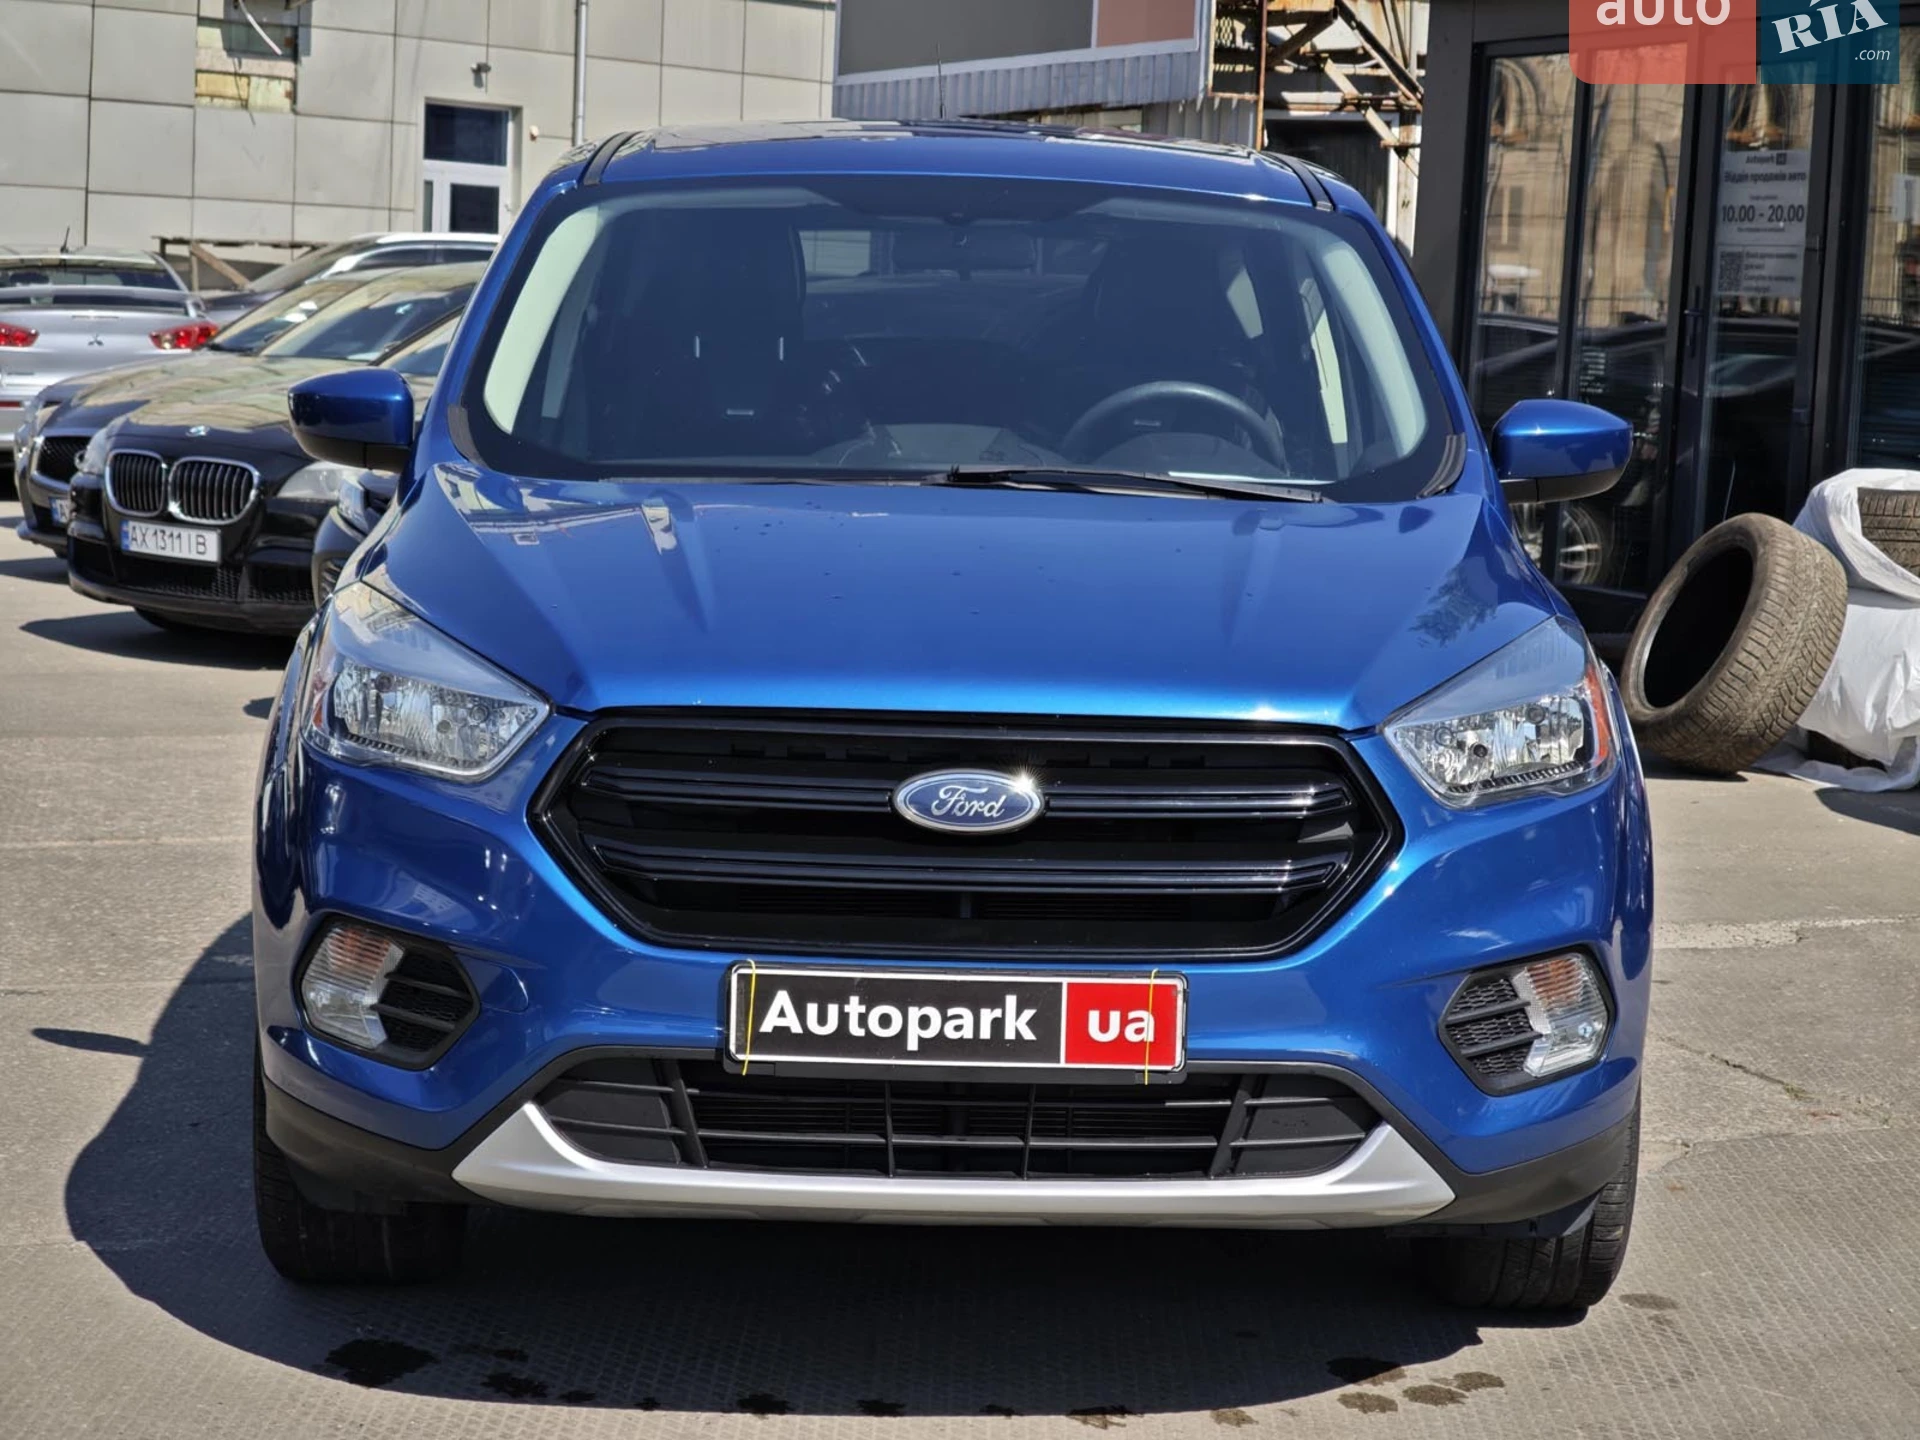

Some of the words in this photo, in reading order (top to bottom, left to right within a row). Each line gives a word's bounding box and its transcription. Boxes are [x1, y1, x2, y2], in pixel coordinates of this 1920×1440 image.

[1722, 204, 1756, 223] 10.00
[1767, 204, 1805, 223] 20.00
[930, 785, 1006, 818] Ford
[759, 989, 1038, 1051] Autopark
[1087, 1008, 1155, 1043] ua
